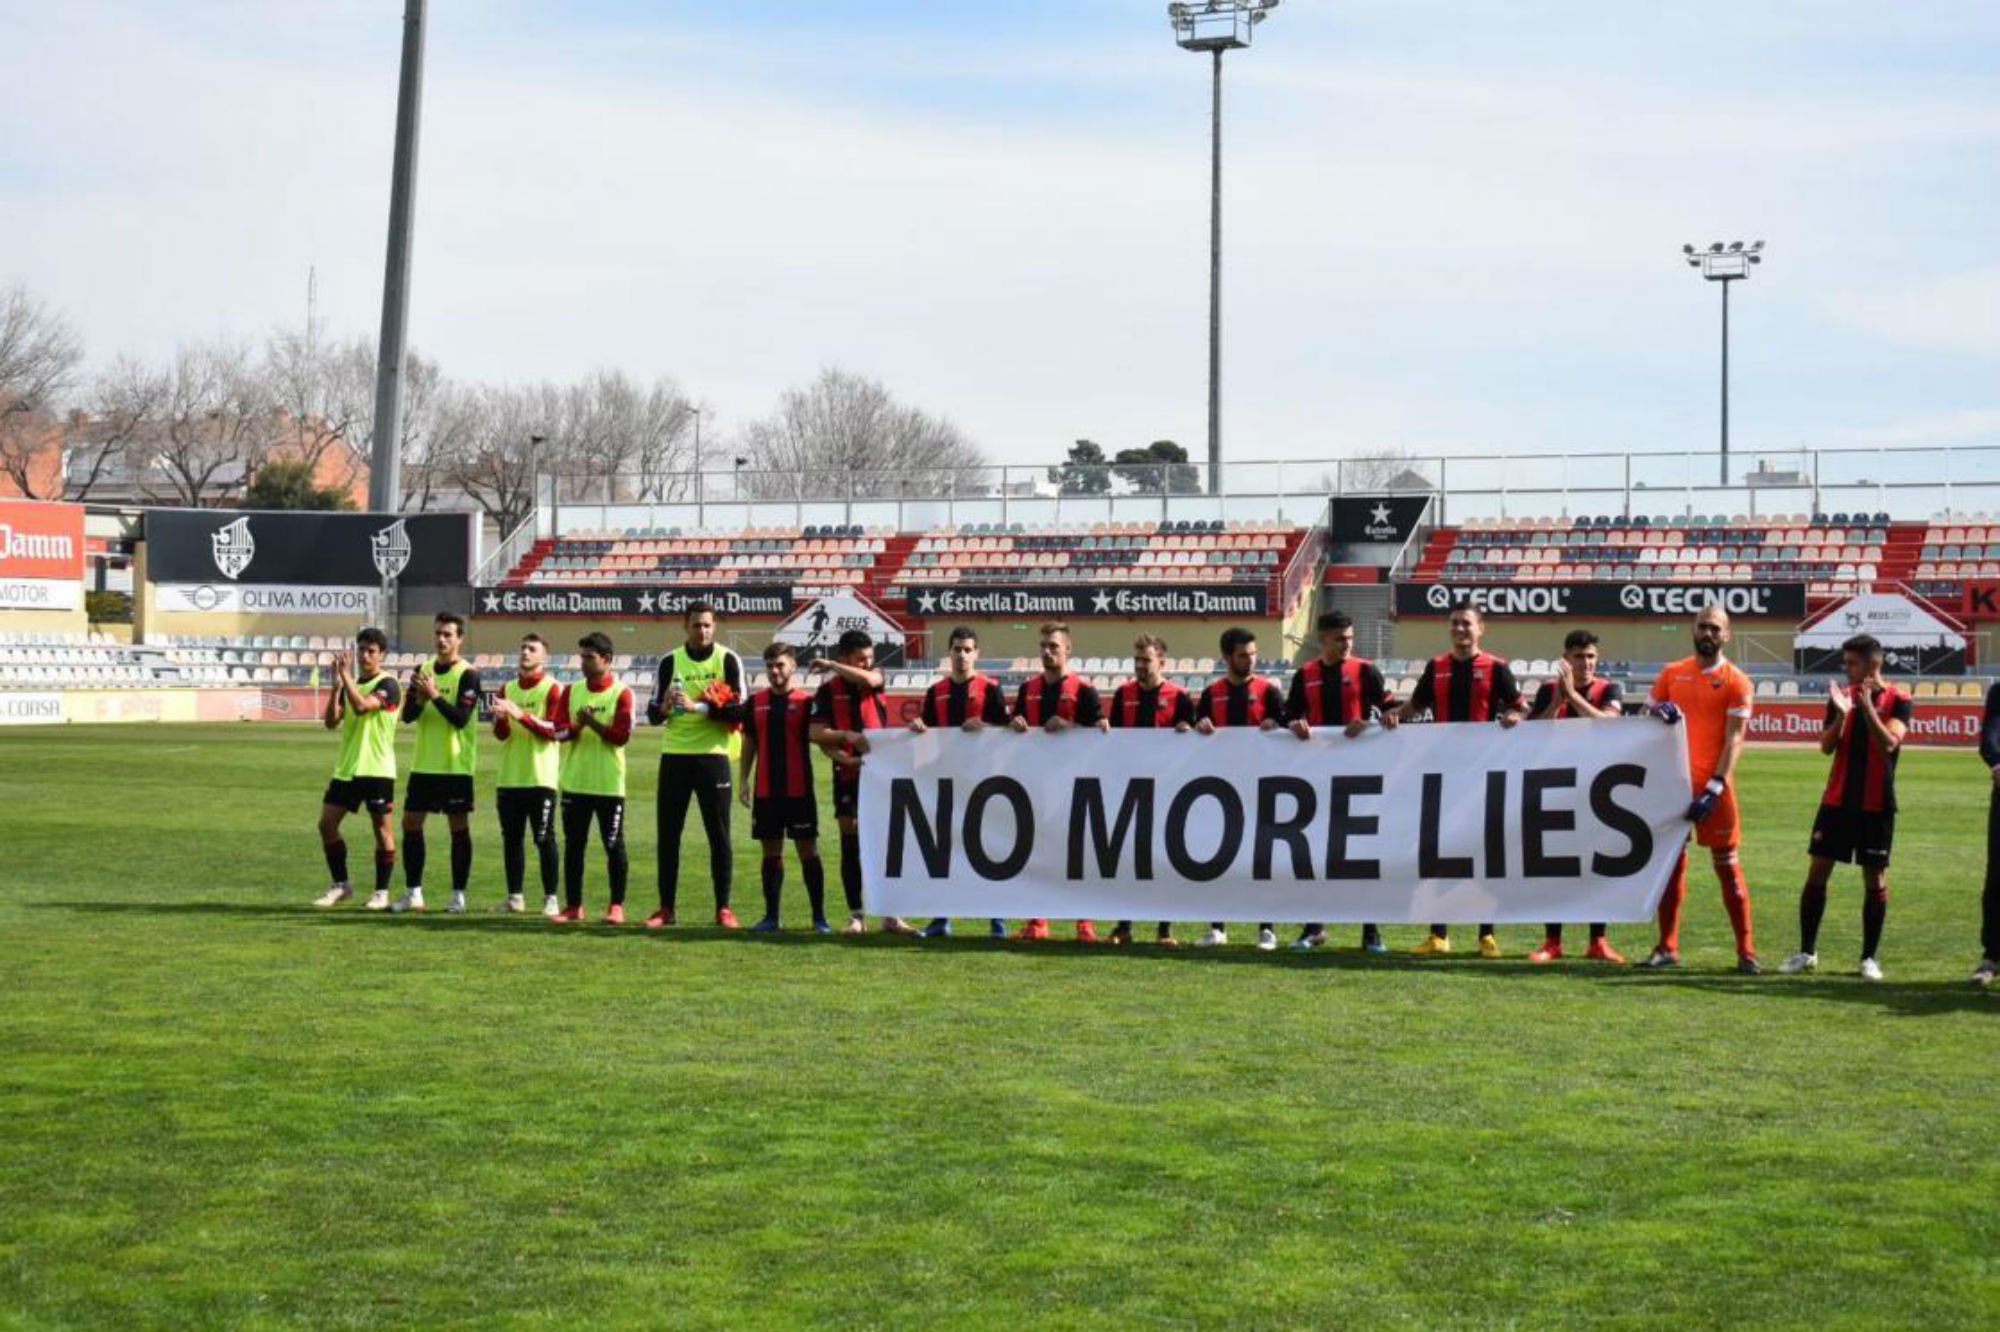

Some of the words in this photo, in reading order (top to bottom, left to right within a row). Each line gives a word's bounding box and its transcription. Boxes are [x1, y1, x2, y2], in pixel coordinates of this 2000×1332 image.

[243, 590, 295, 608] OLIVA
[300, 592, 367, 608] MOTOR
[503, 591, 566, 612] Estrella
[568, 591, 622, 613] Damm
[726, 591, 783, 613] Damm
[940, 590, 1011, 612] Estrella
[1012, 591, 1075, 613] Damm
[1115, 589, 1190, 612] Estrella
[1191, 590, 1257, 613] Damm
[836, 615, 870, 630] REUS
[885, 776, 1035, 881] NO
[1067, 775, 1383, 882] MORE
[1418, 764, 1654, 880] LIES
